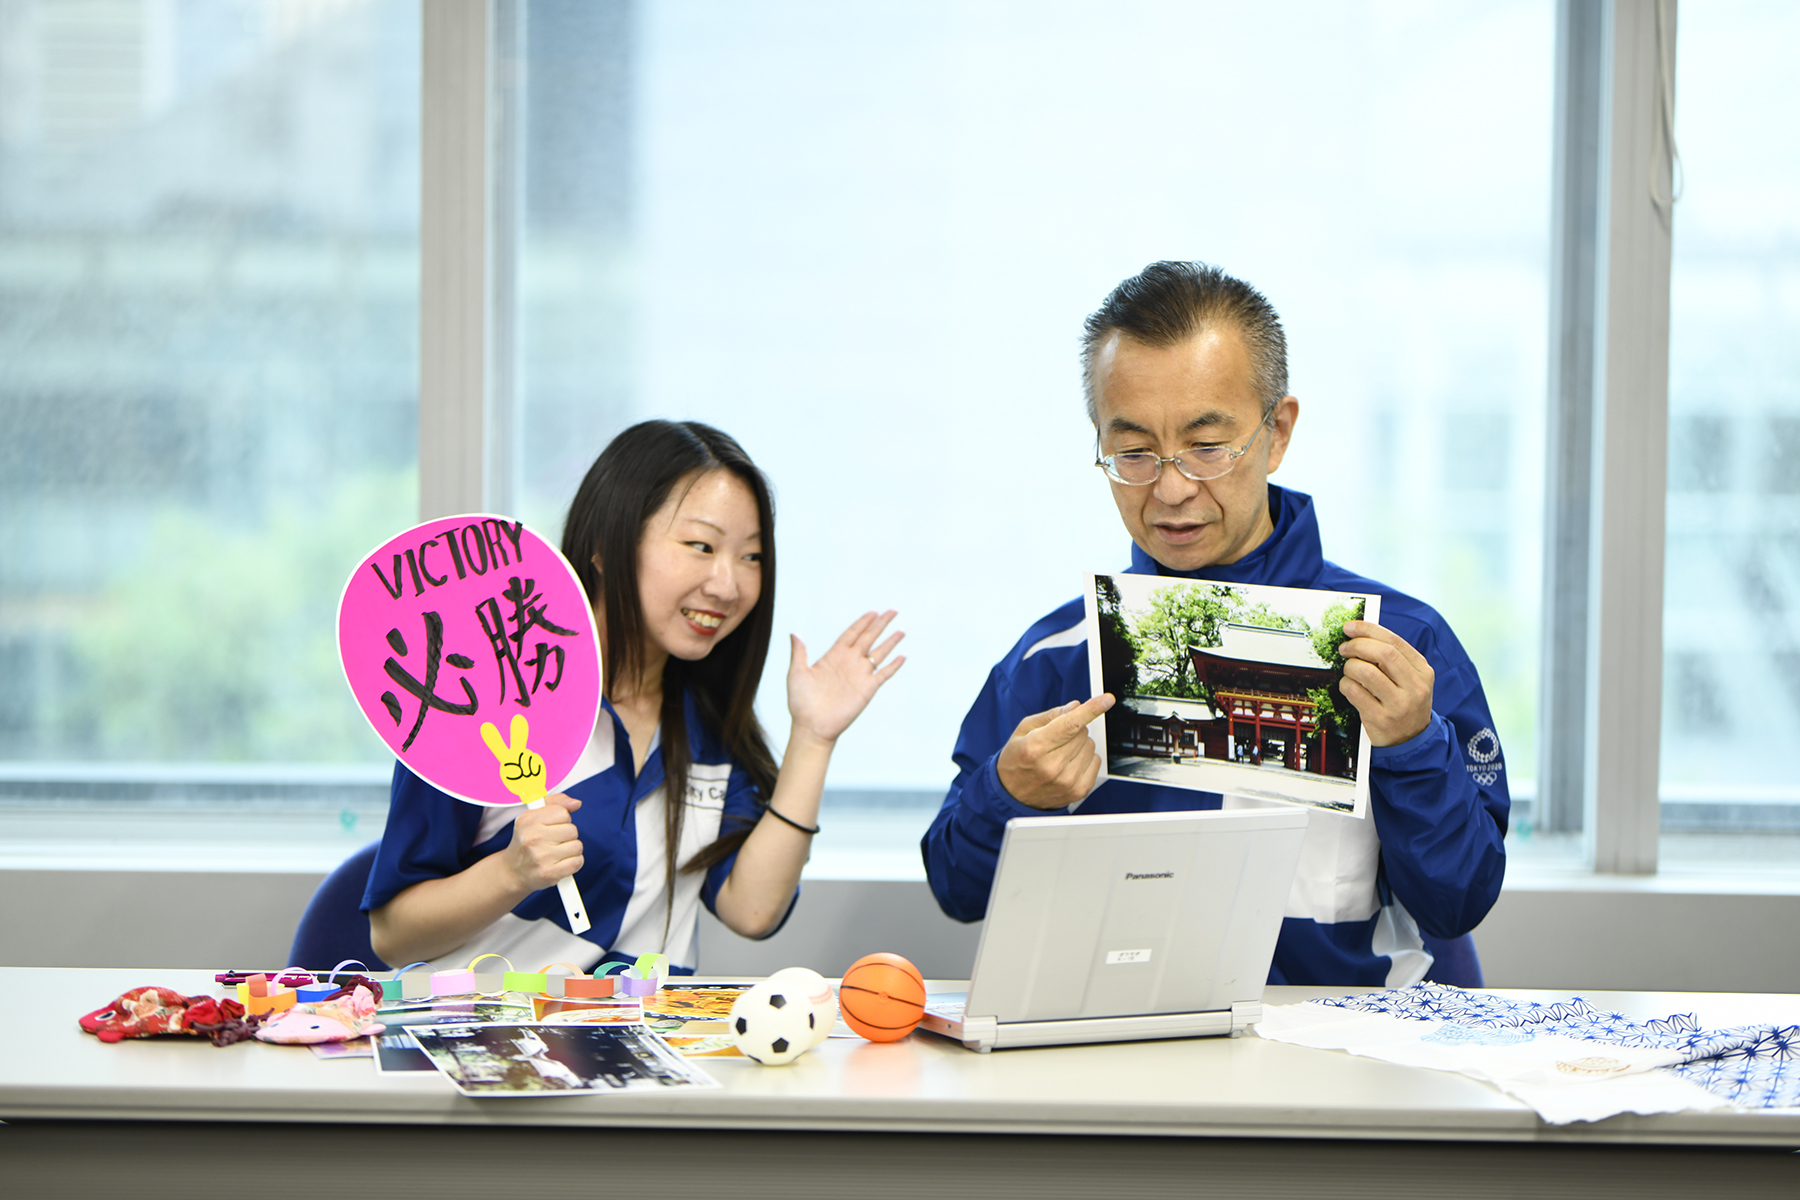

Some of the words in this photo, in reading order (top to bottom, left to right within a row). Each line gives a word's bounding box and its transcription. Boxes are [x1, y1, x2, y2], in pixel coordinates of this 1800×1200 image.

[371, 519, 523, 600] VICTORY
[381, 576, 579, 752] 必勝
[1466, 764, 1486, 773] TOKYO
[1487, 762, 1503, 771] 2020
[1125, 871, 1174, 880] Panasonic
